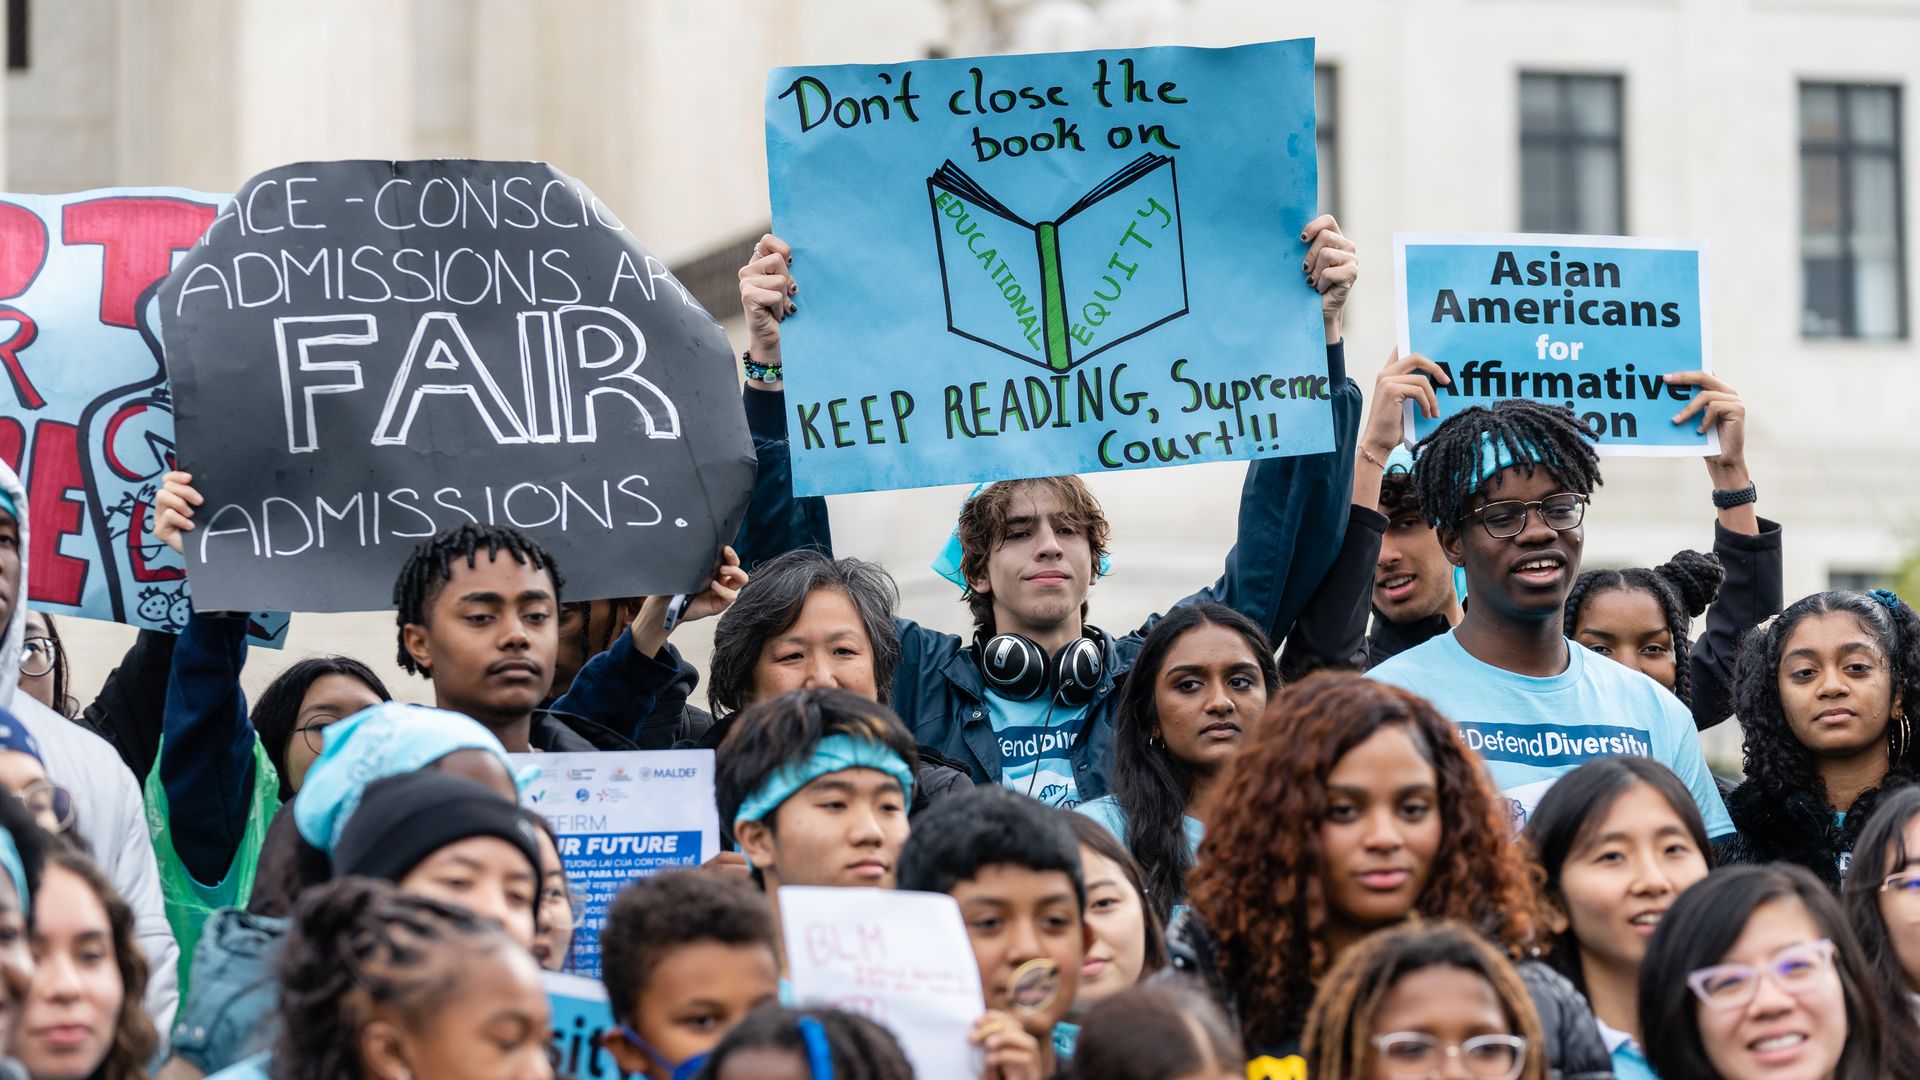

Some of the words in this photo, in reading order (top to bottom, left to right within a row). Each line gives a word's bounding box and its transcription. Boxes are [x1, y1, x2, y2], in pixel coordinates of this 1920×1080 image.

[778, 71, 920, 132] Don't
[949, 67, 1069, 116] close
[1093, 58, 1188, 108] the
[972, 117, 1085, 161] book
[1108, 124, 1180, 149] on
[176, 245, 582, 316] ADMISSIONS
[935, 191, 1042, 351] EDUCATIONAL
[1070, 196, 1172, 346] EQUITY
[1490, 250, 1621, 288] Asian
[1431, 288, 1681, 328] Americans
[1535, 333, 1584, 361] for
[274, 306, 681, 453] FAIR
[797, 390, 915, 450] KEEP
[944, 363, 1159, 439] READING,
[1170, 359, 1331, 437] Supreme
[1433, 360, 1693, 400] Affirmative
[200, 475, 688, 563] ADMISSIONS.
[654, 767, 698, 779] MALDEF
[586, 835, 678, 856] FUTURE
